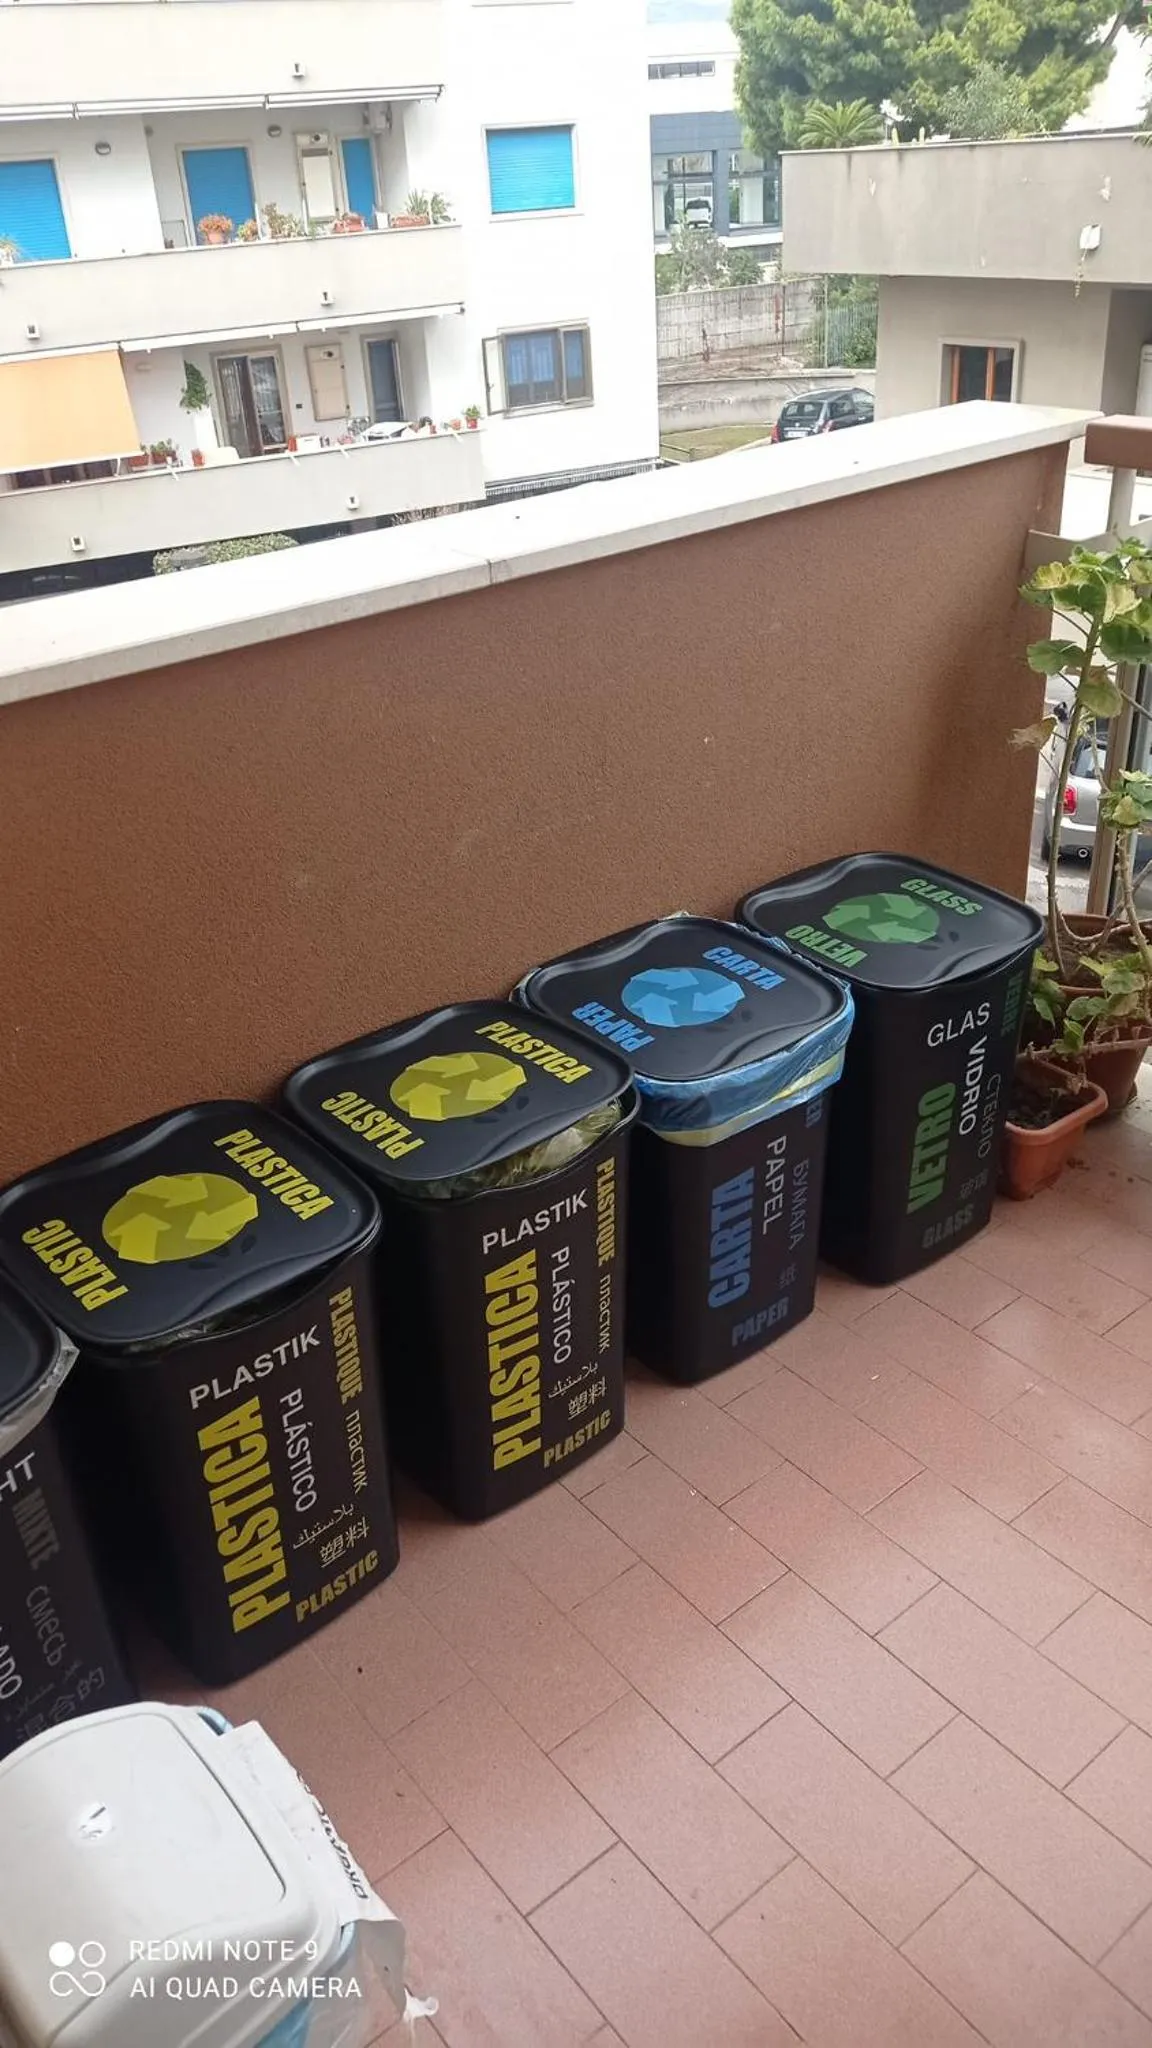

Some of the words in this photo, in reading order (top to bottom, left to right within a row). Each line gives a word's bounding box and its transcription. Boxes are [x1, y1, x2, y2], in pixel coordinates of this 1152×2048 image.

[900, 878, 983, 916] GLASS
[702, 946, 786, 992] CARTA
[785, 925, 868, 968] VETRO
[474, 1021, 593, 1084] PLASTICA
[571, 1001, 656, 1052] PAPER
[926, 1002, 991, 1048] GLAS
[321, 1091, 425, 1160] PLASTIC
[958, 1035, 988, 1136] VIDRIO
[213, 1129, 335, 1220] PLASTICA
[762, 1135, 787, 1235] PAPEL
[906, 1082, 956, 1215] VETRO
[482, 1189, 588, 1255] PLASTIK
[596, 1156, 617, 1267] PLASTIQUE
[708, 1167, 755, 1309] CARTA
[21, 1219, 129, 1312] PLASTIC
[551, 1246, 576, 1364] PLÁSTICO
[329, 1286, 364, 1405] PLASTIQUE
[484, 1249, 541, 1471] PLASTICA
[731, 1297, 789, 1347] PAPER
[189, 1324, 321, 1410] PLASTIK
[279, 1388, 318, 1513] PLÁSTICO
[543, 1409, 611, 1469] PLASTIC
[197, 1395, 291, 1633] PLASTICA
[295, 1549, 380, 1623] PLASTIC
